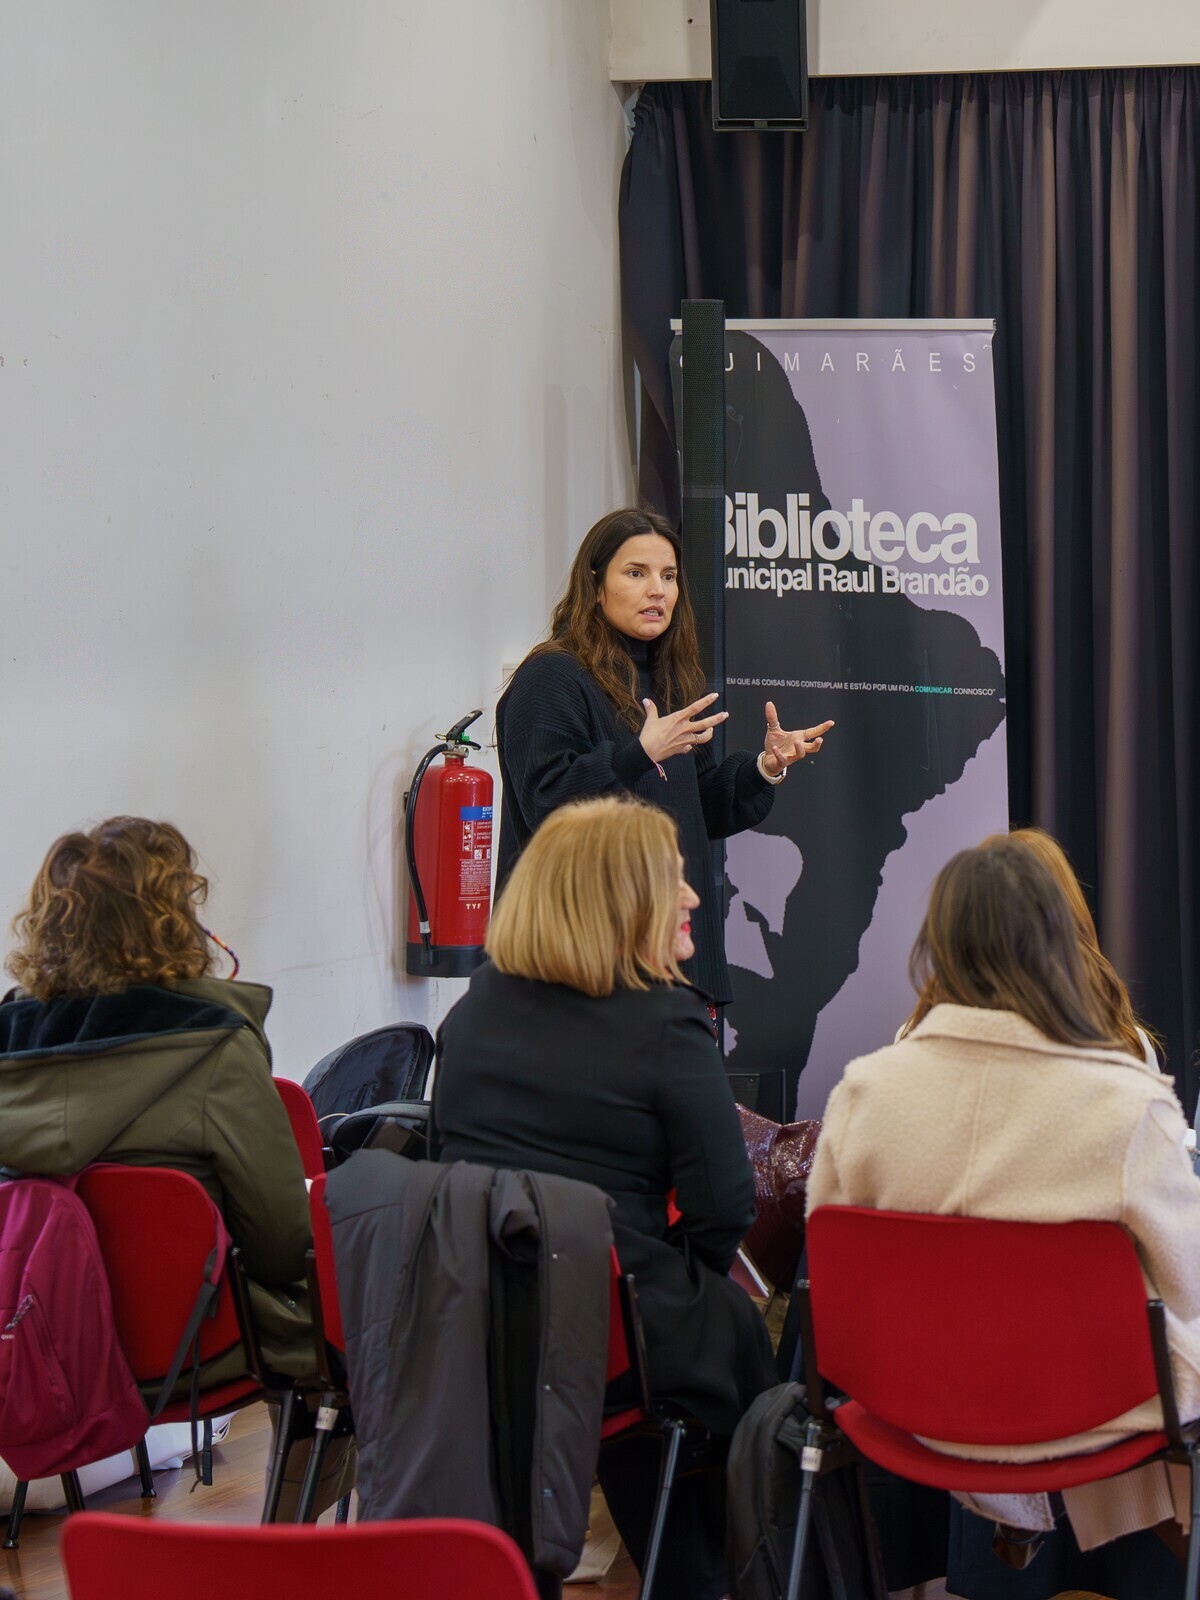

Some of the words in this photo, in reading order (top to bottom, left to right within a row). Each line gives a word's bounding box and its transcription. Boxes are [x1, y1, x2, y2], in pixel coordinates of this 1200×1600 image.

[680, 348, 976, 372] UIMARÃES
[818, 563, 875, 594] Raul
[882, 565, 989, 597] Brandão
[737, 677, 751, 686] QUE
[752, 678, 760, 686] AS
[761, 678, 785, 687] COISAS
[786, 679, 800, 688] NOS
[800, 680, 843, 689] CONTEMPLAM
[844, 682, 849, 690] E
[850, 681, 871, 690] ESTÃO
[872, 683, 887, 691] POR
[888, 684, 898, 692] UM
[899, 684, 909, 693] FIO
[915, 685, 952, 694] COMUNICAR
